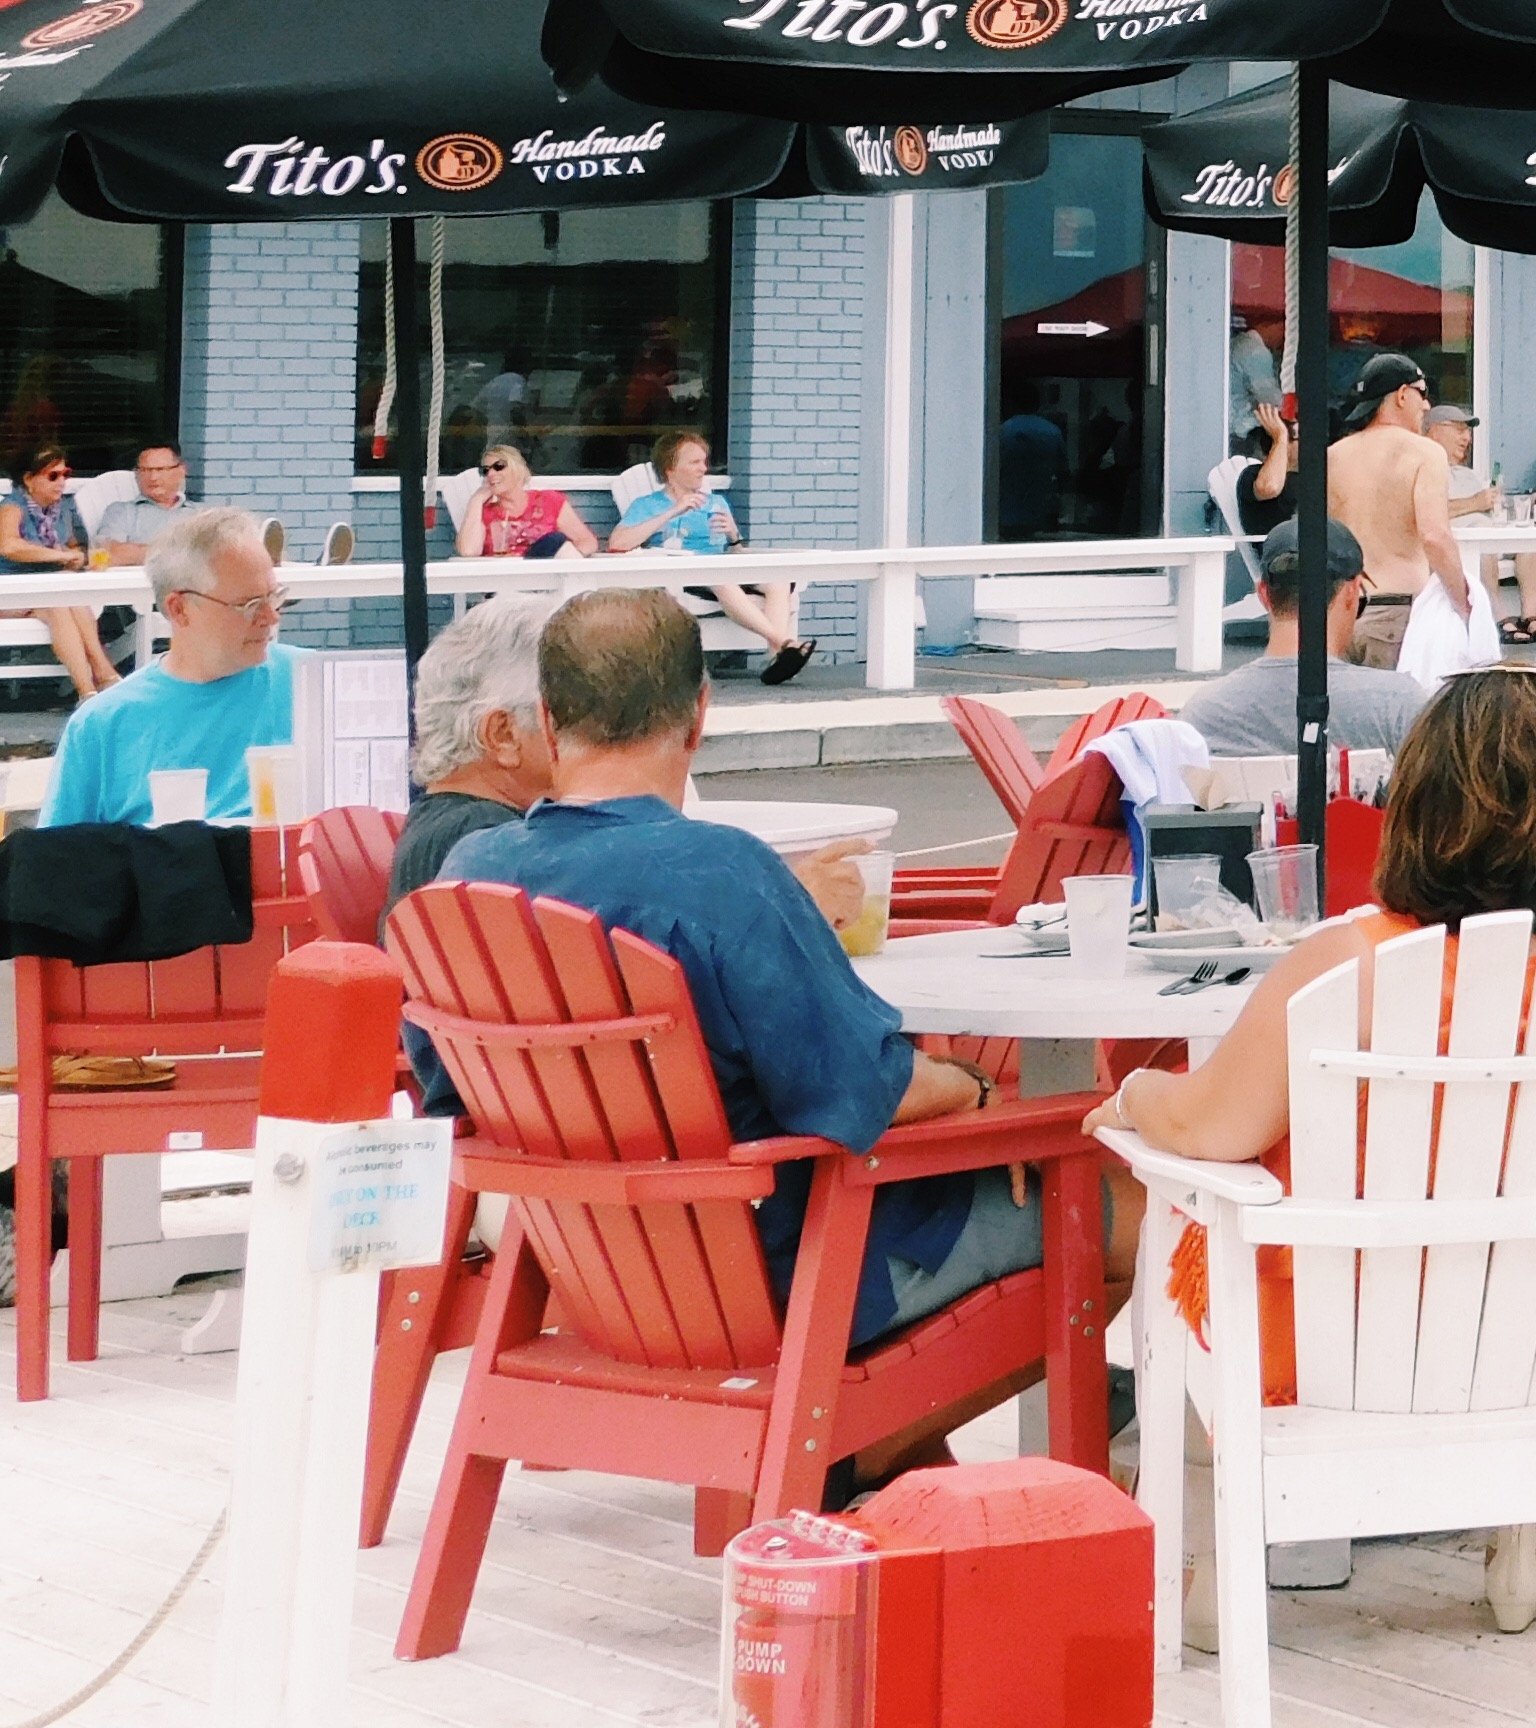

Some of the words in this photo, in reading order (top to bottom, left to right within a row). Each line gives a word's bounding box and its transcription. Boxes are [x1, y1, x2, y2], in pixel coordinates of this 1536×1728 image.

[1095, 3, 1208, 43] VODKA
[511, 120, 667, 164] Handmade
[926, 123, 1002, 152] Handmade
[532, 156, 646, 184] VODKA
[354, 1141, 410, 1157] beverages
[414, 1140, 437, 1152] may
[759, 1590, 810, 1607] BUTTON
